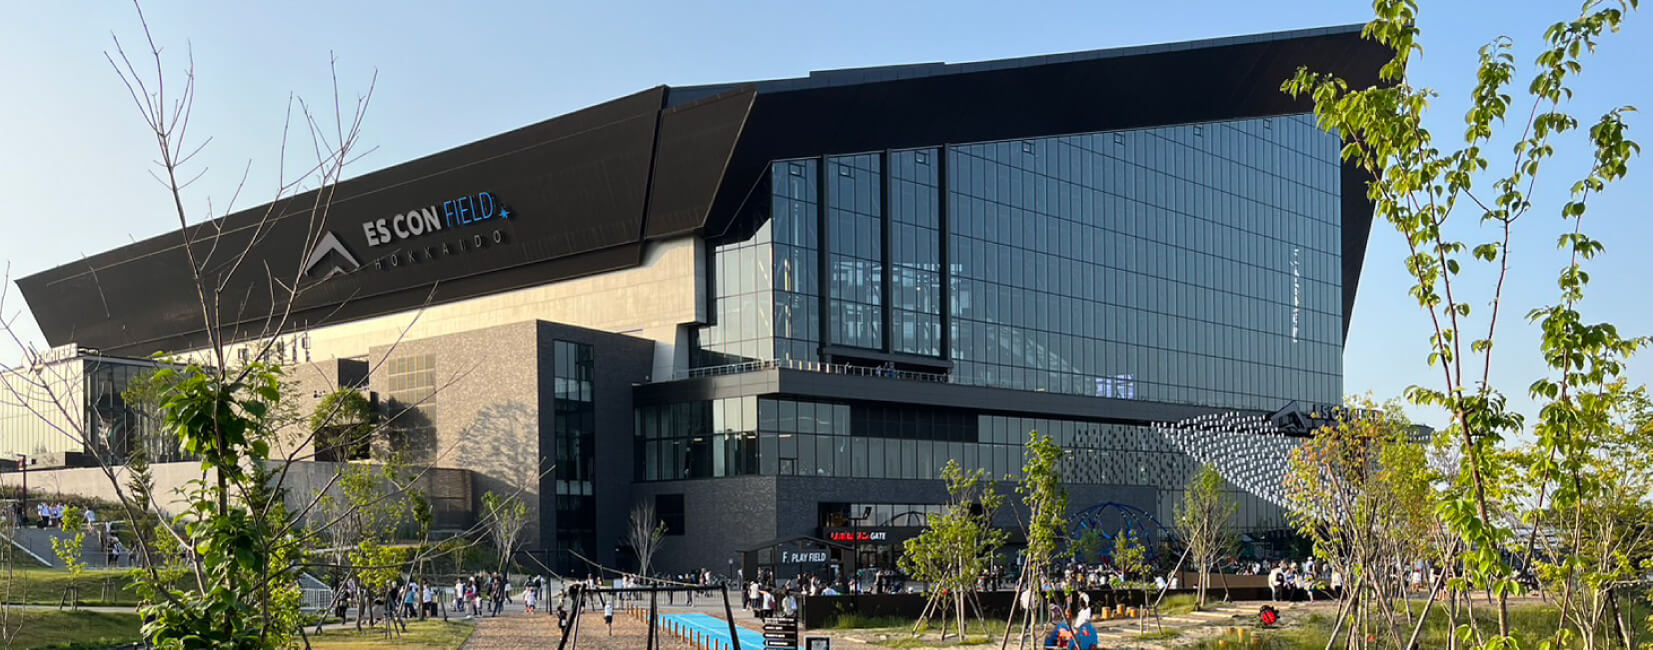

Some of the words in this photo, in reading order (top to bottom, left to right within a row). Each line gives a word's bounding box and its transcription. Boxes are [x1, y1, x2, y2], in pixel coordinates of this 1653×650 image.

[362, 218, 391, 246] ES
[393, 206, 442, 239] CON
[443, 192, 495, 227] FIELD
[375, 230, 502, 270] HOKKAIDO
[870, 531, 886, 541] GATE
[791, 552, 808, 562] PLAY
[808, 552, 827, 562] FIELD
